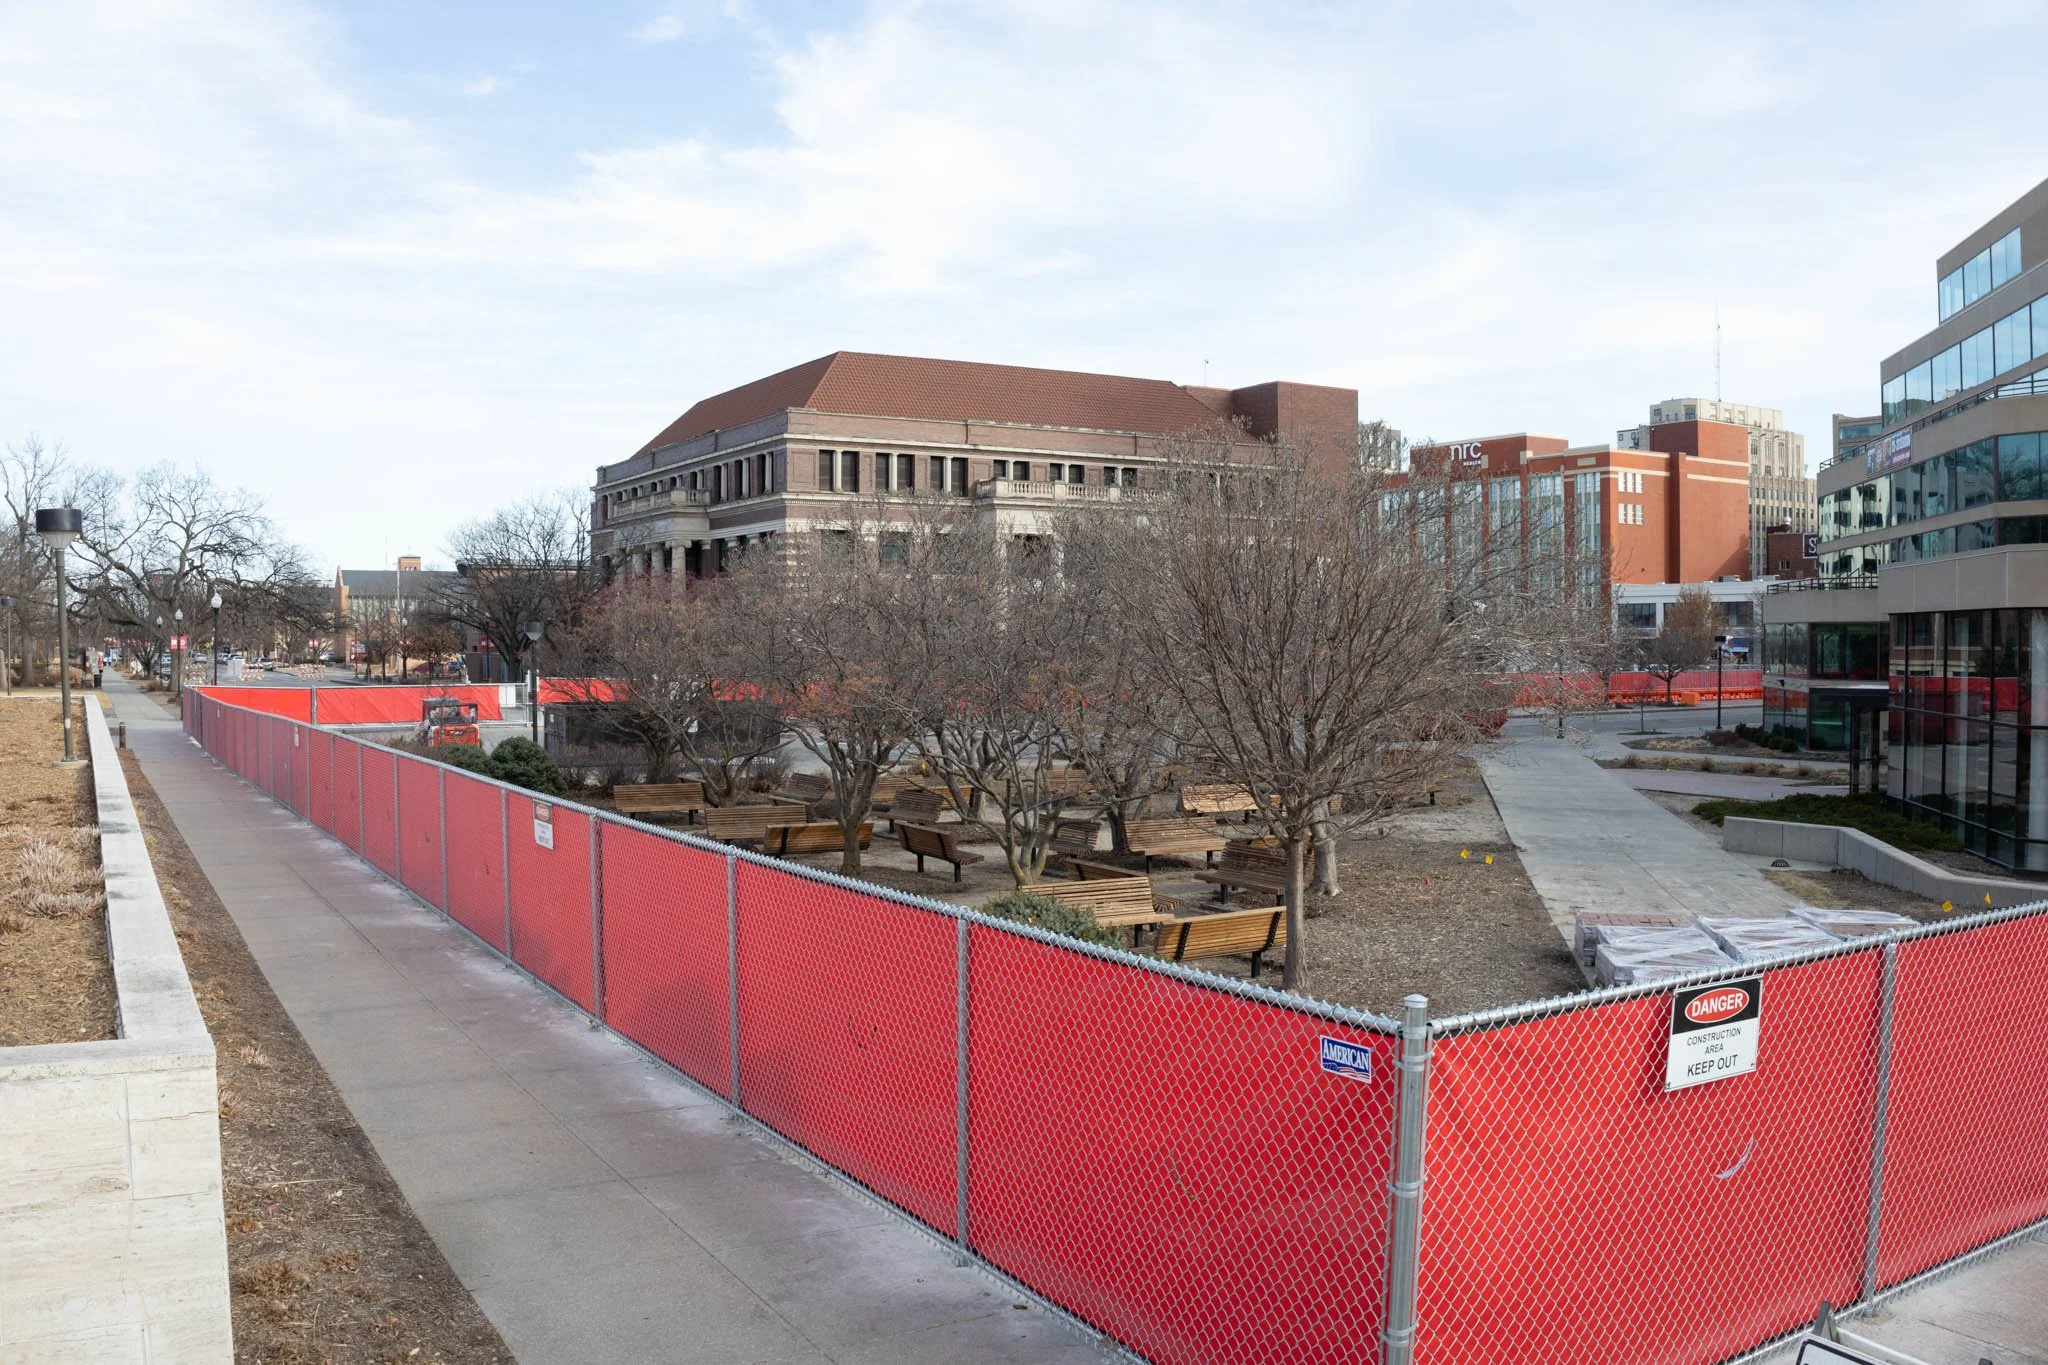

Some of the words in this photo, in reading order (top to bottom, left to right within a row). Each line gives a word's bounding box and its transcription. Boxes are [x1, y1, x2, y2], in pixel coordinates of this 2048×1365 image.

[1450, 442, 1482, 460] nrc
[1691, 993, 1743, 1017] DANGER
[1687, 1027, 1741, 1046] CONSTRUCTION
[1323, 1039, 1369, 1071] AMERICAN
[1704, 1044, 1724, 1055] AREA
[1687, 1059, 1714, 1077] KEEP
[1718, 1055, 1738, 1070] OUT
